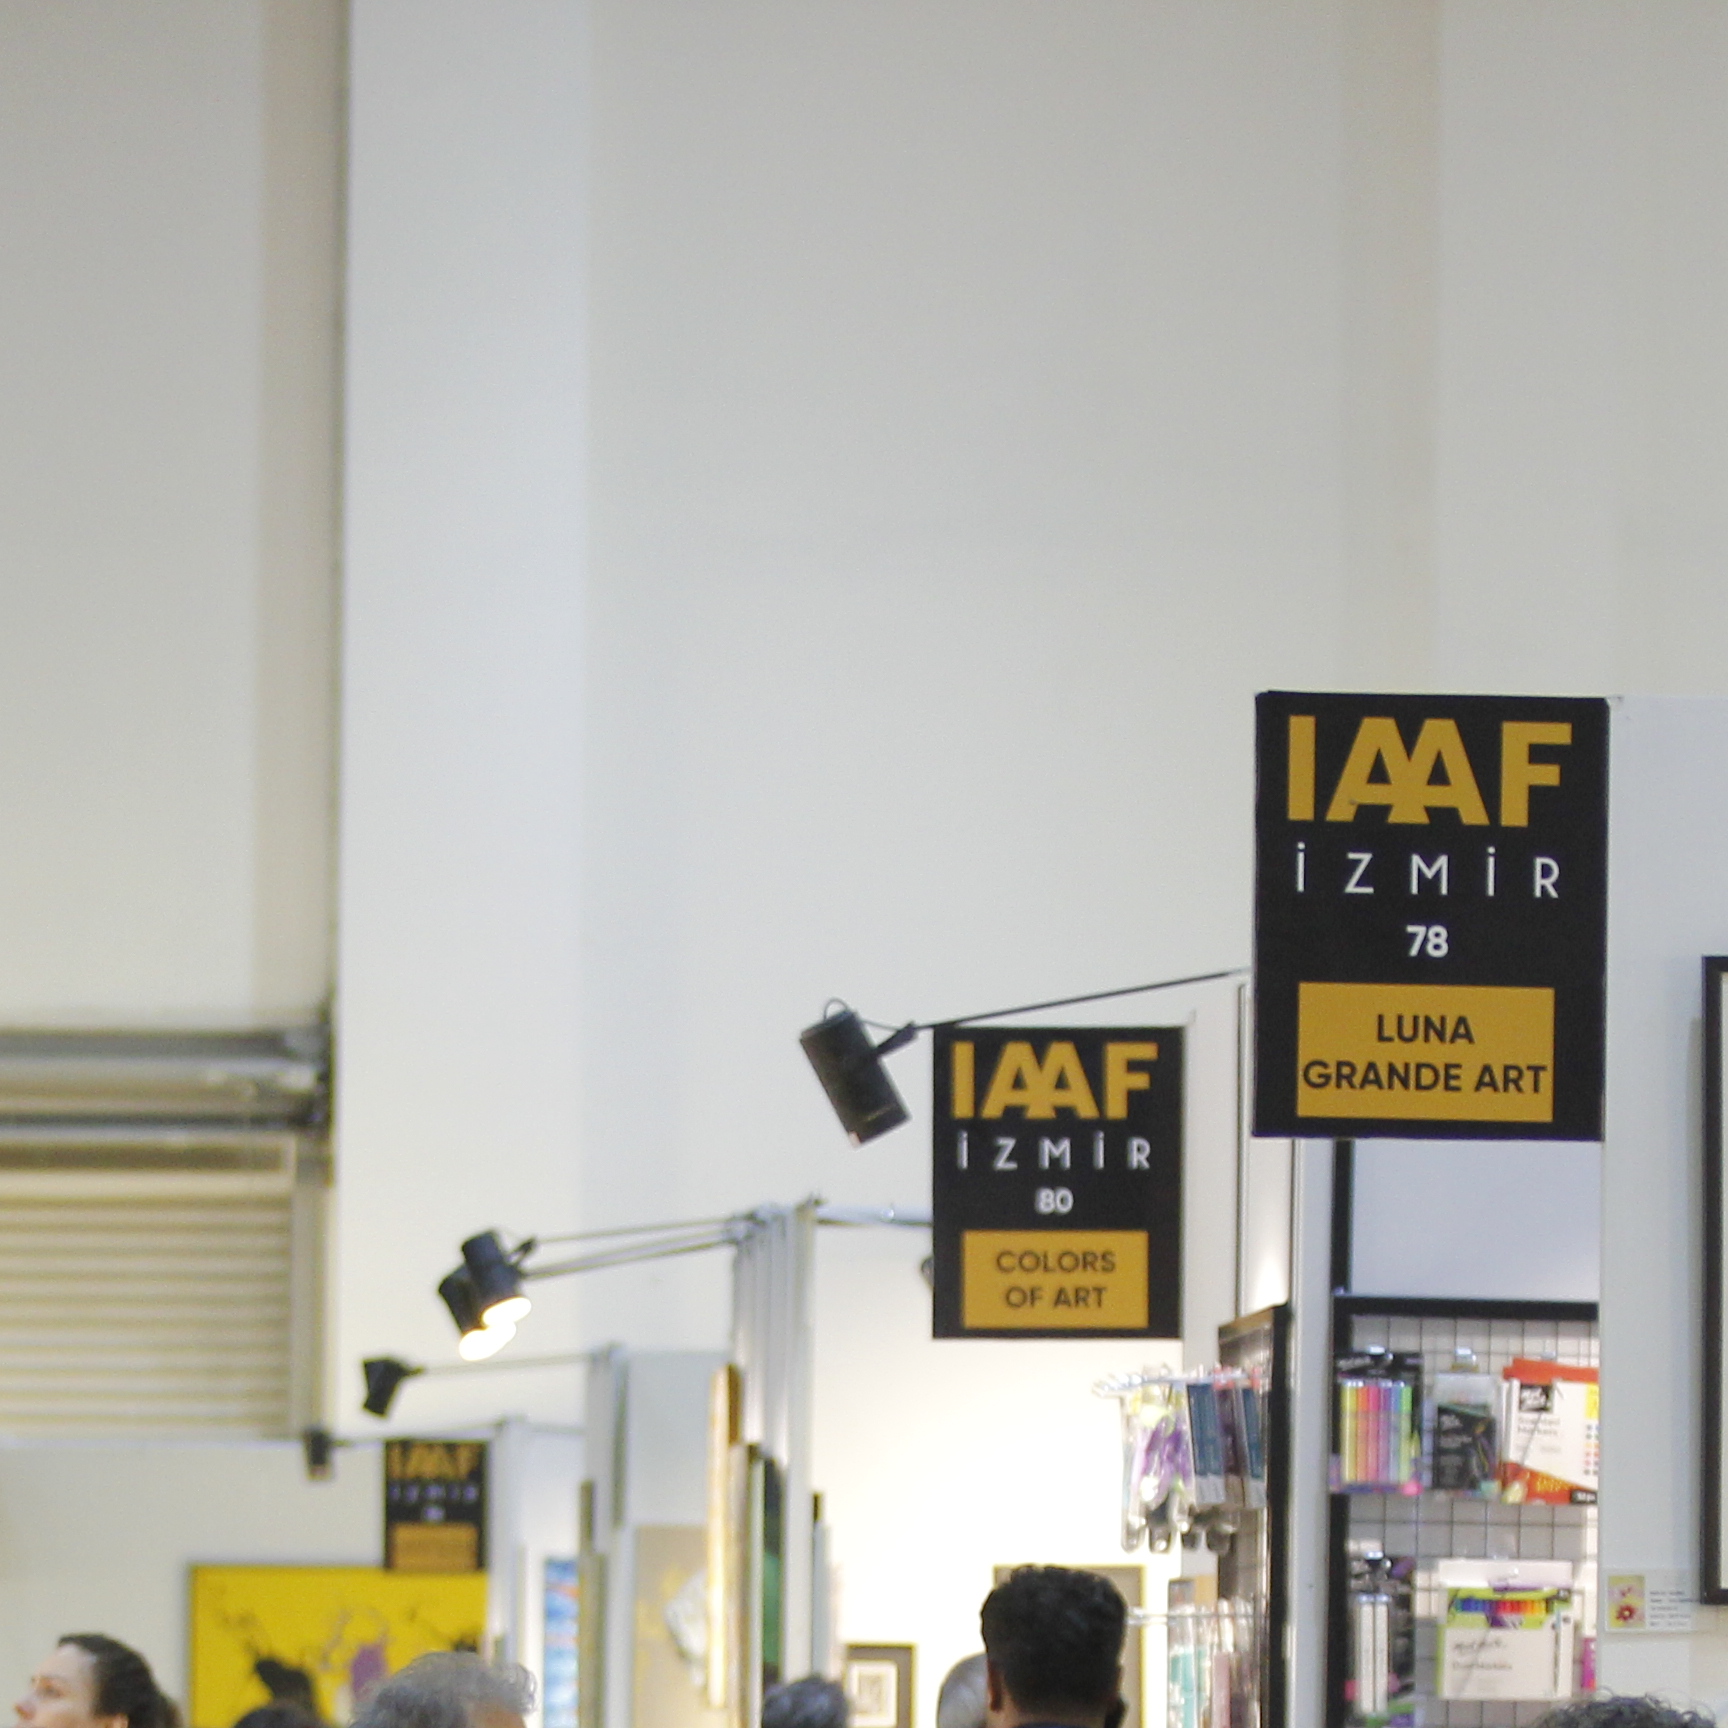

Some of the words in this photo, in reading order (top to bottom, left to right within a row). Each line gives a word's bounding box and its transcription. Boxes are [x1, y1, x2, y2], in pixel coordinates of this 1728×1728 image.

[1287, 715, 1572, 827] IAAF
[1296, 843, 1560, 899] İZMİR
[1407, 925, 1449, 958] 78
[1376, 1014, 1476, 1045] LUNA
[950, 1041, 1158, 1120] IAAF
[1303, 1060, 1463, 1093] GRANDE
[1475, 1063, 1547, 1095] ART
[956, 1129, 1151, 1172] İZMİR
[1035, 1188, 1073, 1214] 80
[996, 1251, 1116, 1275] COLORS
[1004, 1285, 1045, 1310] OF
[1051, 1285, 1106, 1310] ART
